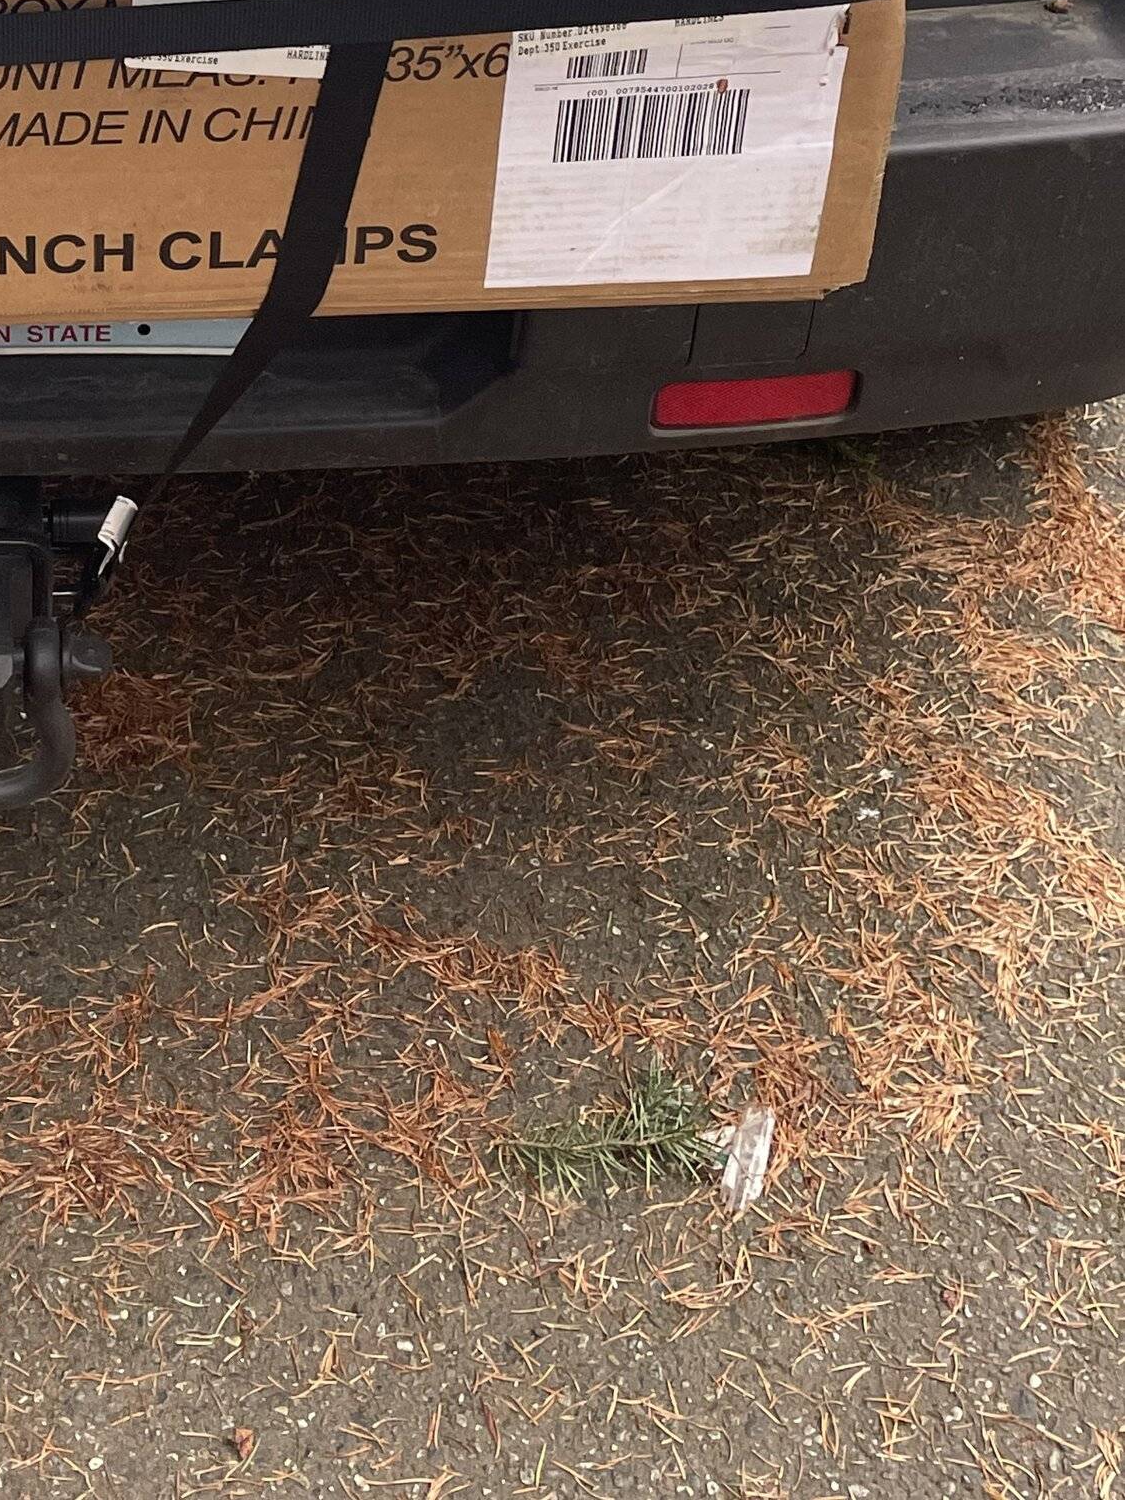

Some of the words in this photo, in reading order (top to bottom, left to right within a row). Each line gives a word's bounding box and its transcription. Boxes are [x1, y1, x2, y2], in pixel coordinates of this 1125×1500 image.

[517, 32, 535, 43] SKU
[517, 45, 540, 57] Dept
[561, 38, 607, 51] Exercise
[615, 82, 727, 96] 0079544700102028
[138, 108, 192, 145] IN
[203, 103, 317, 143] CHI
[158, 223, 438, 271] CLAPS
[27, 324, 112, 343] STATE
